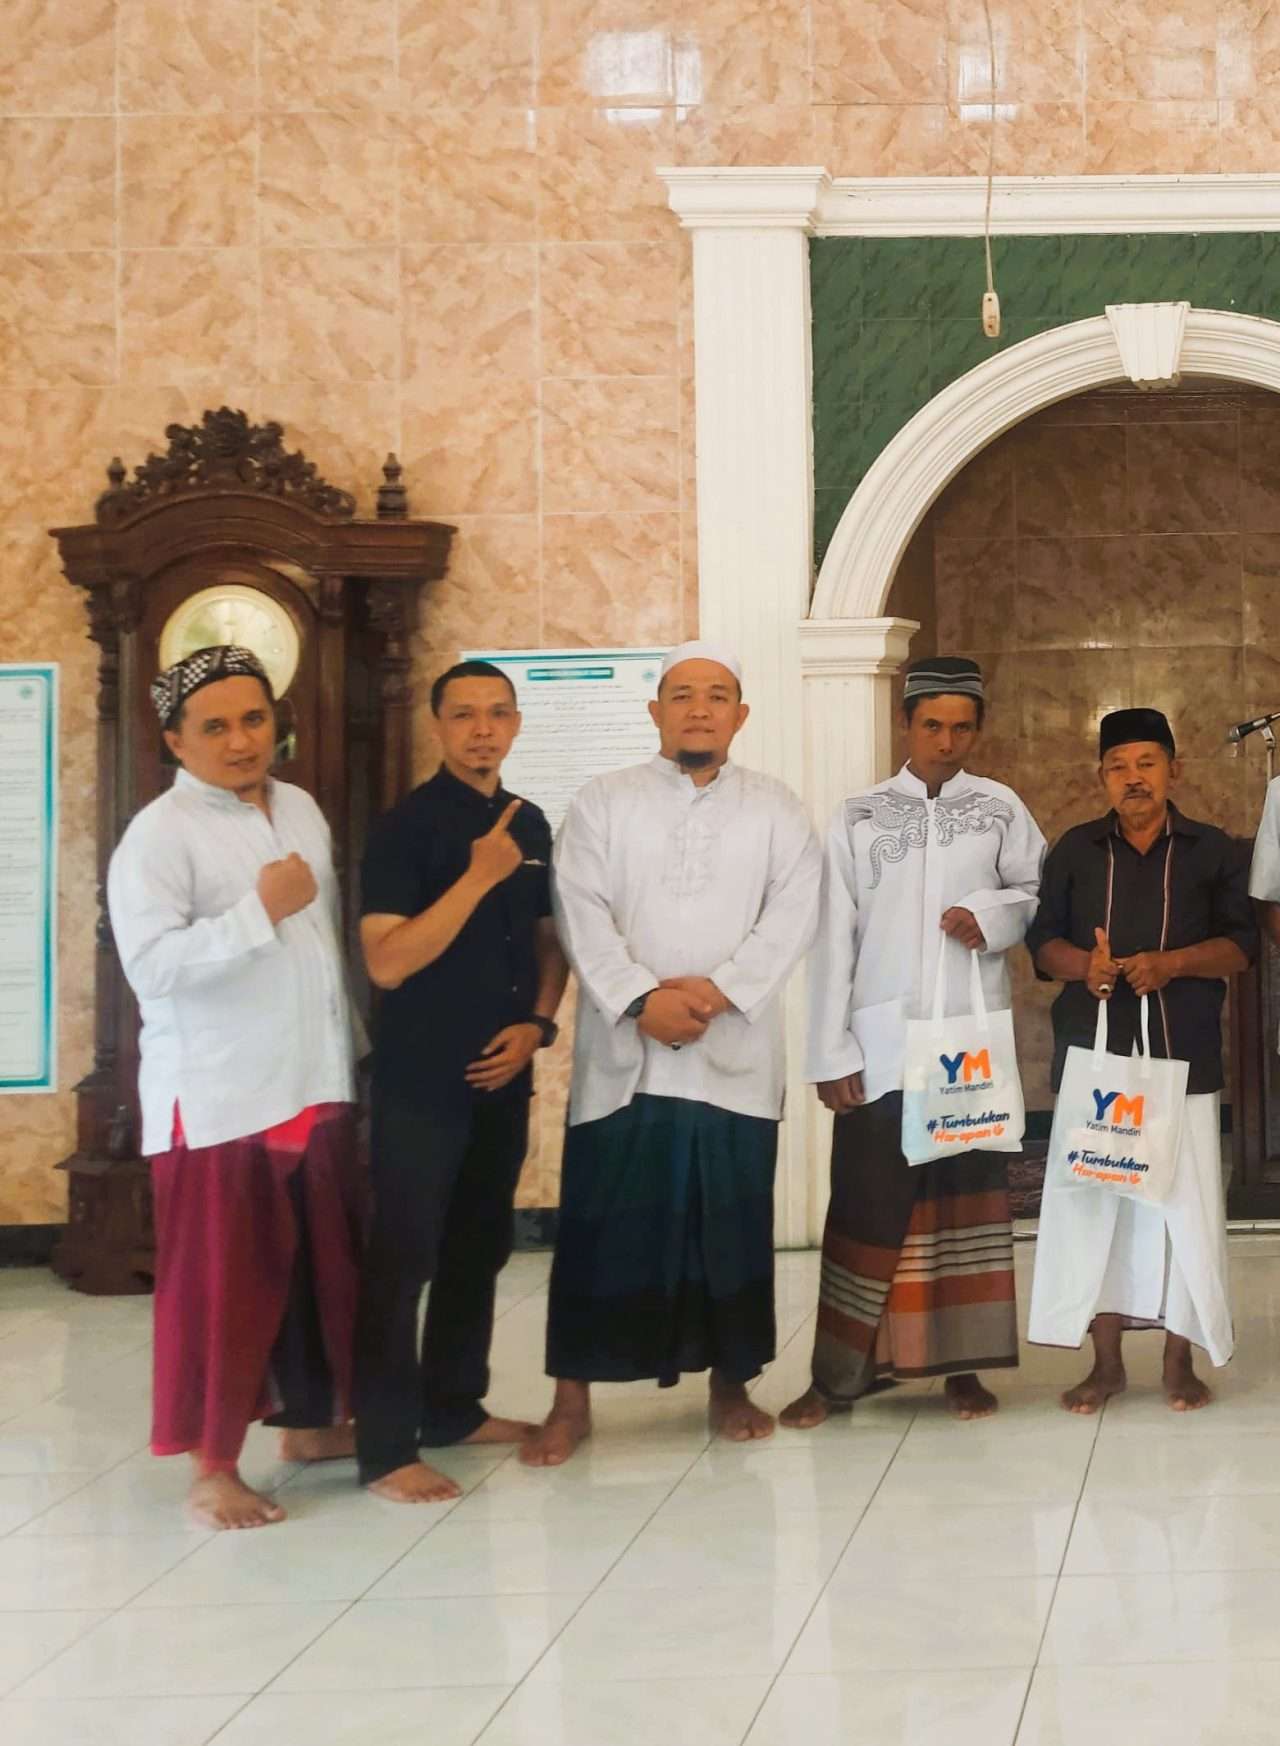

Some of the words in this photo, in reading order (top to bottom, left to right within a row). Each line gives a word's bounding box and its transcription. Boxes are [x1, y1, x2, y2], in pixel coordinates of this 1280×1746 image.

[939, 1048, 992, 1084] YM
[1092, 1088, 1144, 1127] YM
[1086, 1120, 1109, 1132] Yatim
[1110, 1124, 1142, 1137] Mandiri
